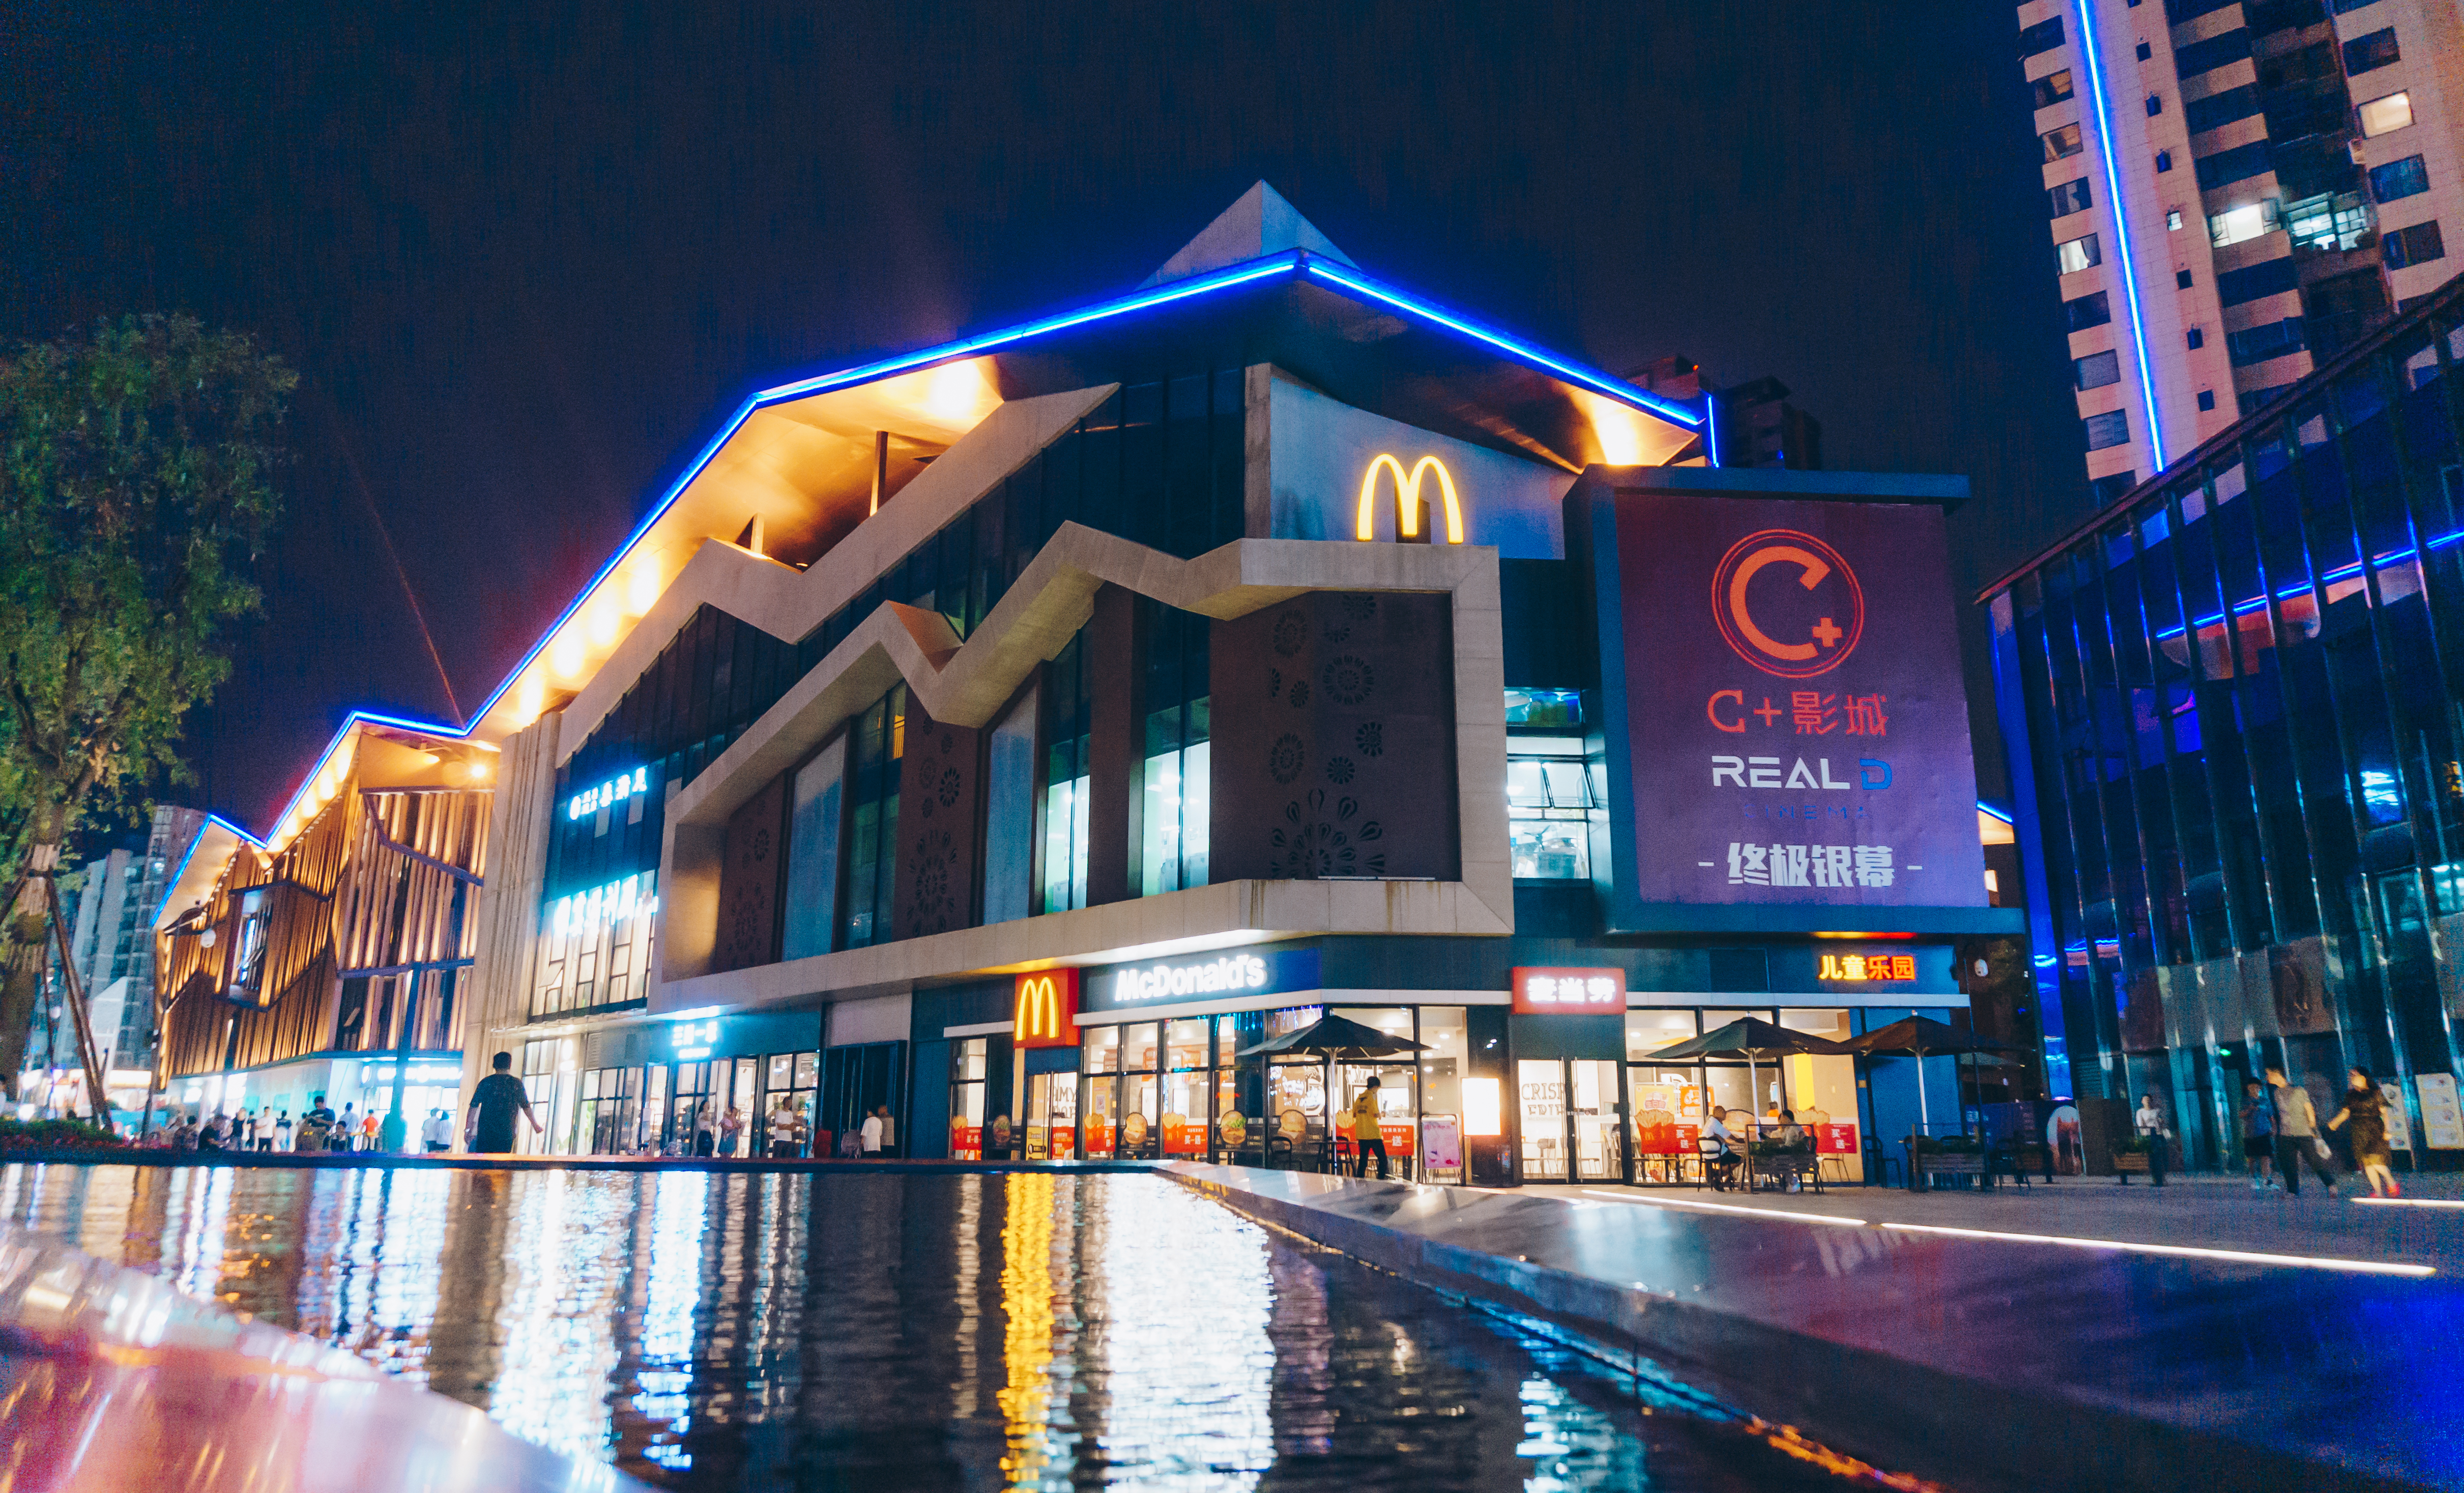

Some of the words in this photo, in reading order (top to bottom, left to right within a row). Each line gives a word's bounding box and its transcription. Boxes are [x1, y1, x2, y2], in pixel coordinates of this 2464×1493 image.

[1712, 755, 1851, 789] REAL
[1859, 758, 1893, 790] D
[1727, 842, 1896, 887] 终极银幕
[1114, 954, 1267, 1001] McDonald's
[1818, 954, 1916, 981] 儿童乐园
[1527, 977, 1615, 1002] 麦当劳
